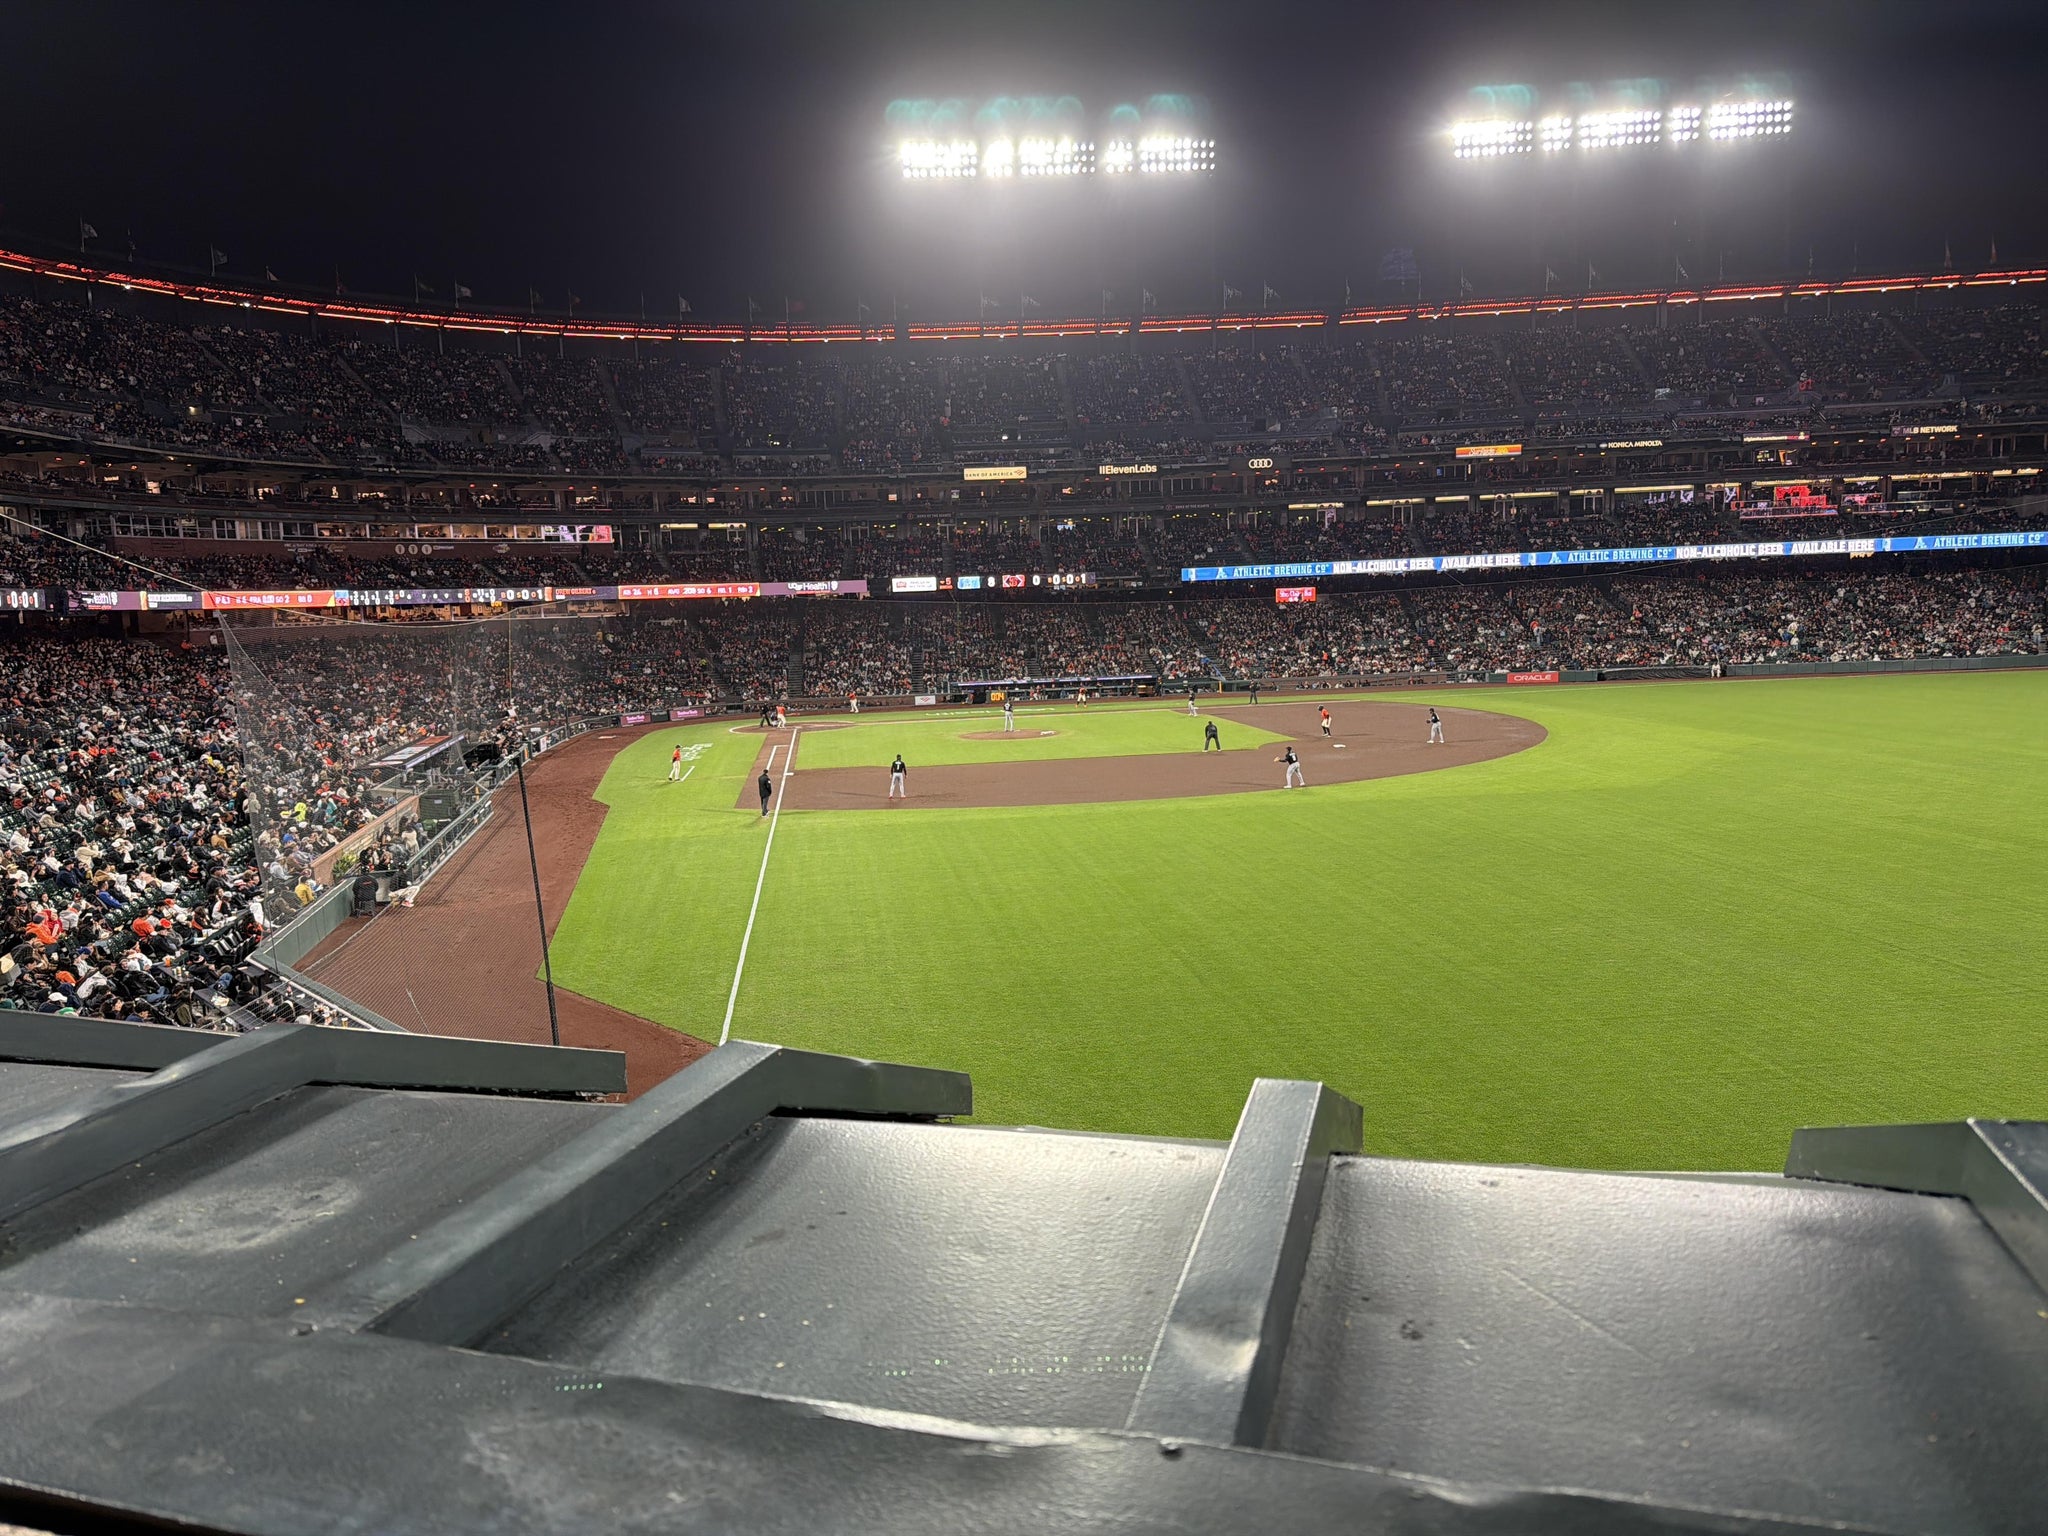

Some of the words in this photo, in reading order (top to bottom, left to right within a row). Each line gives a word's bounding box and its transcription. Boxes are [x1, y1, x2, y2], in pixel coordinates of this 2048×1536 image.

[1903, 426, 1919, 434] MLB
[1920, 425, 1958, 433] NETWORK
[1934, 537, 1978, 548] ATHLETIC
[1981, 535, 2025, 545] BREWING
[1676, 544, 1756, 558] NON-ALCOHOLIC
[1758, 543, 1784, 556] BEER
[1791, 541, 1847, 554] AVAILABLE
[1848, 539, 1875, 551] HERE
[1568, 551, 1609, 562] ATHLETIC
[1613, 549, 1653, 560] BREWING
[1333, 560, 1408, 574] NON-ALCOHOLIC
[1409, 558, 1434, 570] BEER
[1441, 555, 1494, 568] AVAILABLE
[1495, 554, 1521, 566] HERE
[1233, 567, 1272, 577] ATHLETIC
[1274, 564, 1312, 575] BREWING
[945, 577, 952, 585] 5
[987, 576, 995, 587] 8
[1033, 575, 1040, 585] 0
[1053, 574, 1060, 584] 0
[1066, 574, 1073, 584] 0
[1081, 573, 1086, 584] 1
[803, 582, 828, 590] Health
[11, 591, 18, 608] 0
[22, 591, 29, 608] 0
[33, 591, 39, 608] 1
[506, 589, 515, 600] 0
[522, 589, 530, 600] 0
[537, 589, 543, 599] 1
[991, 692, 1004, 701] 004
